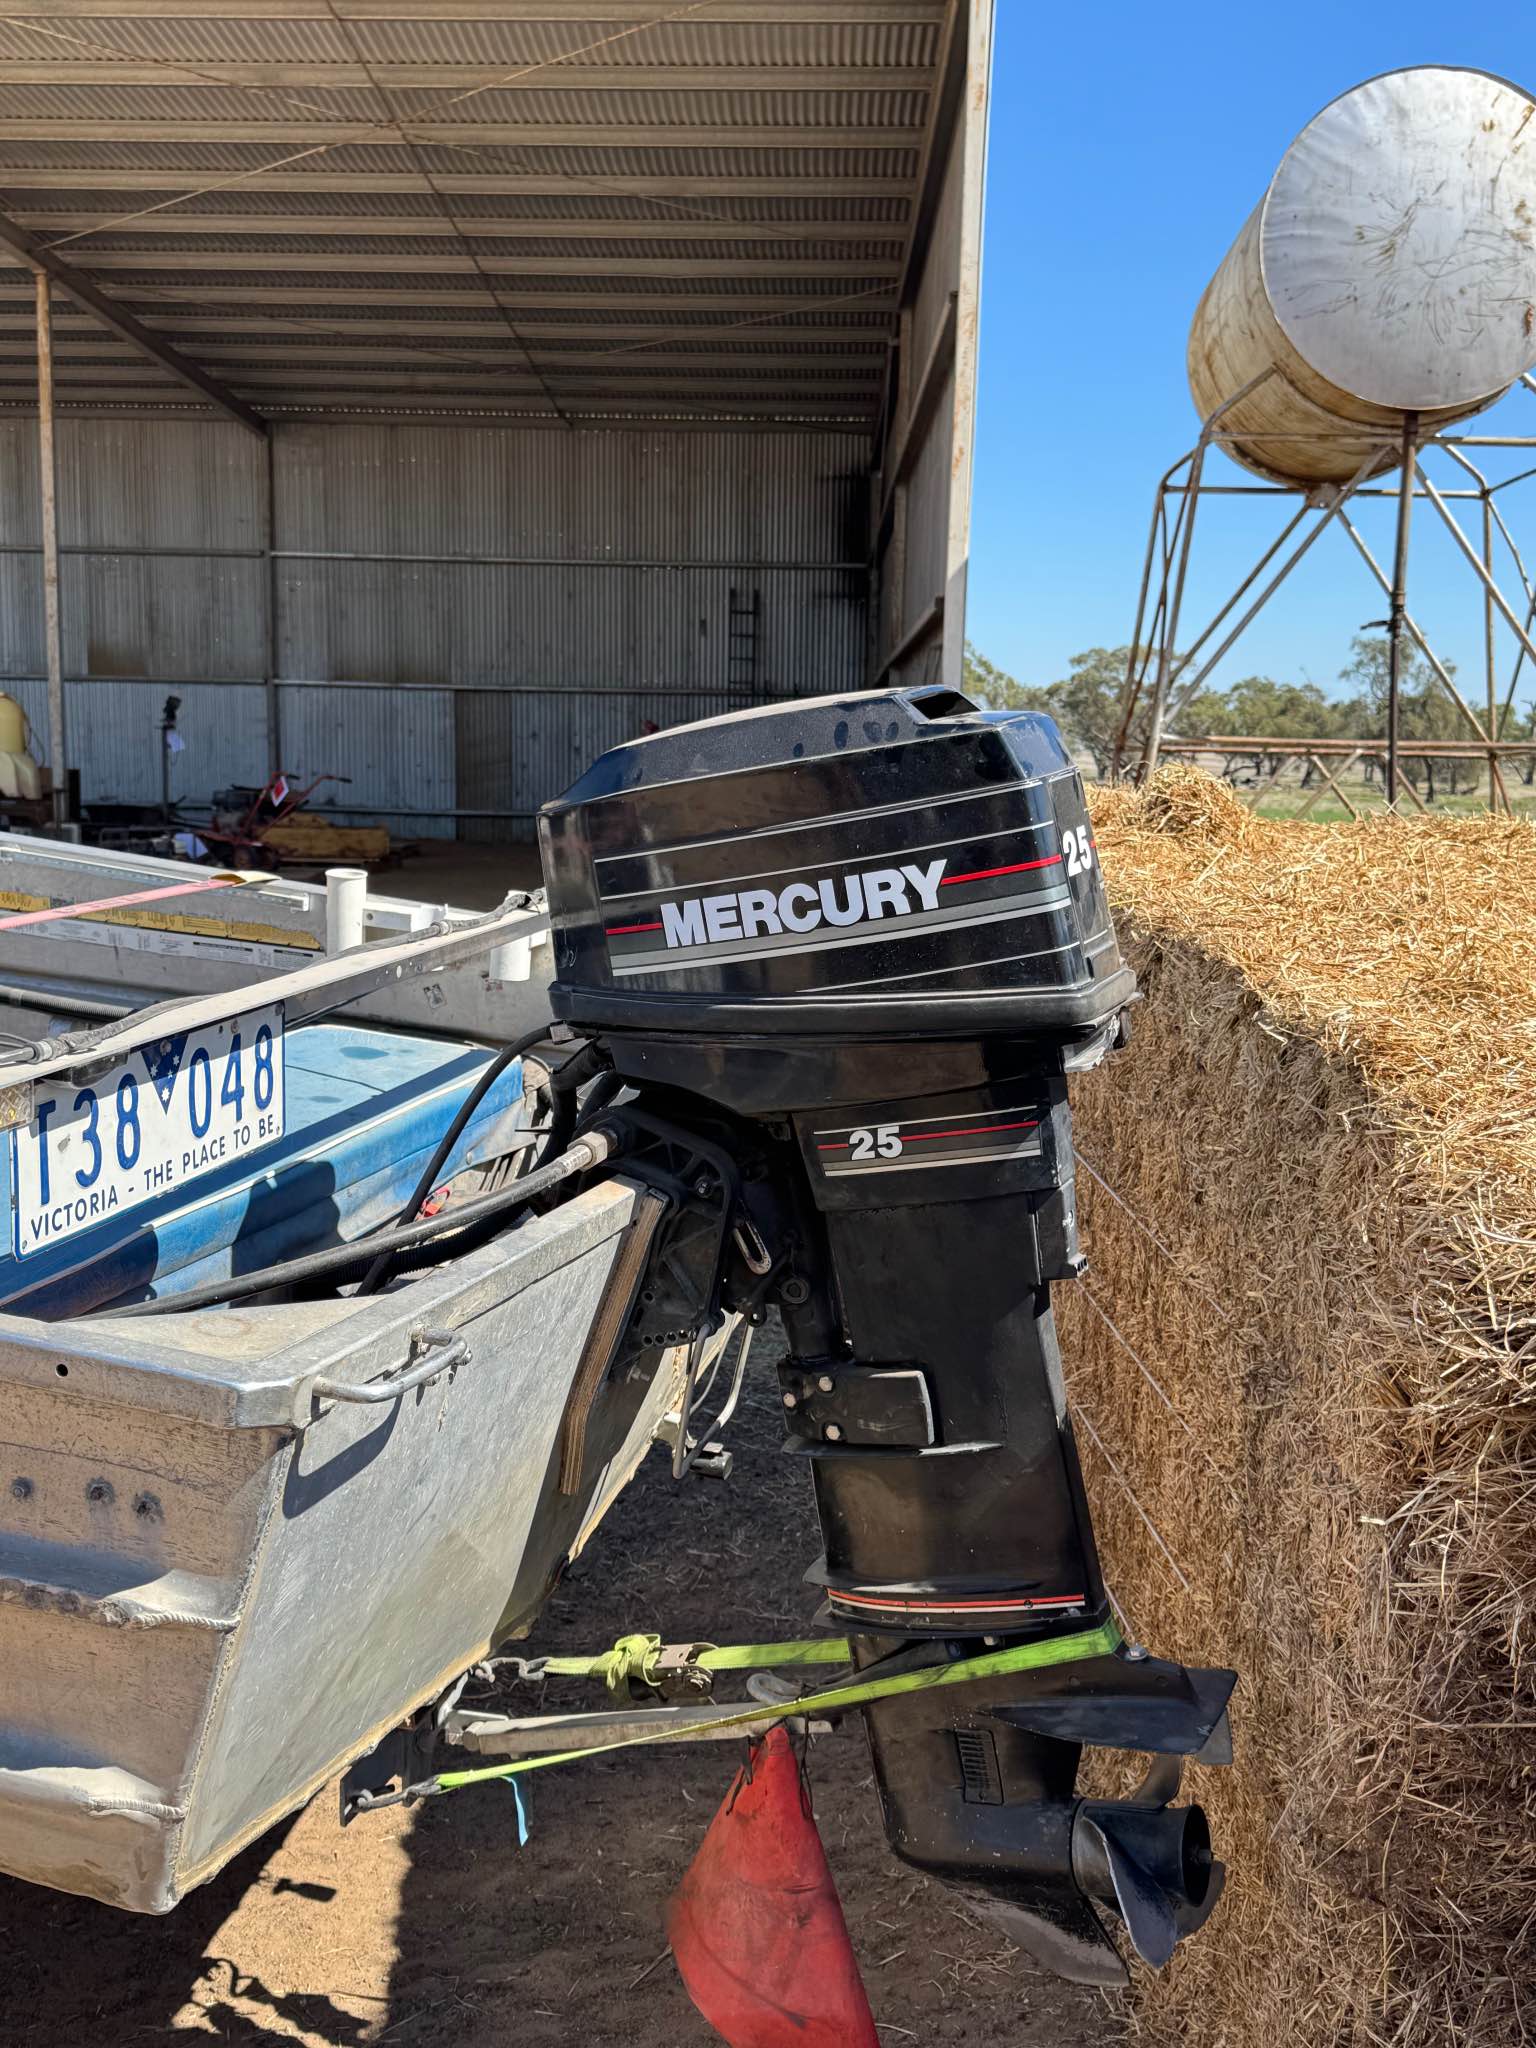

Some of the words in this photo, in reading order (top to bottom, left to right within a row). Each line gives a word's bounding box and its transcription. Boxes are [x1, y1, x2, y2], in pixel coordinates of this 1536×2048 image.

[1063, 825, 1091, 877] 25
[660, 859, 947, 950] MERCURY
[34, 1073, 142, 1206] T38
[188, 1024, 274, 1139] 048
[849, 1126, 903, 1161] 25
[31, 1185, 118, 1240] VICTORIA
[144, 1160, 173, 1191] THE
[183, 1139, 226, 1174] PLACE
[233, 1126, 251, 1149] TO
[258, 1114, 274, 1137] BE
